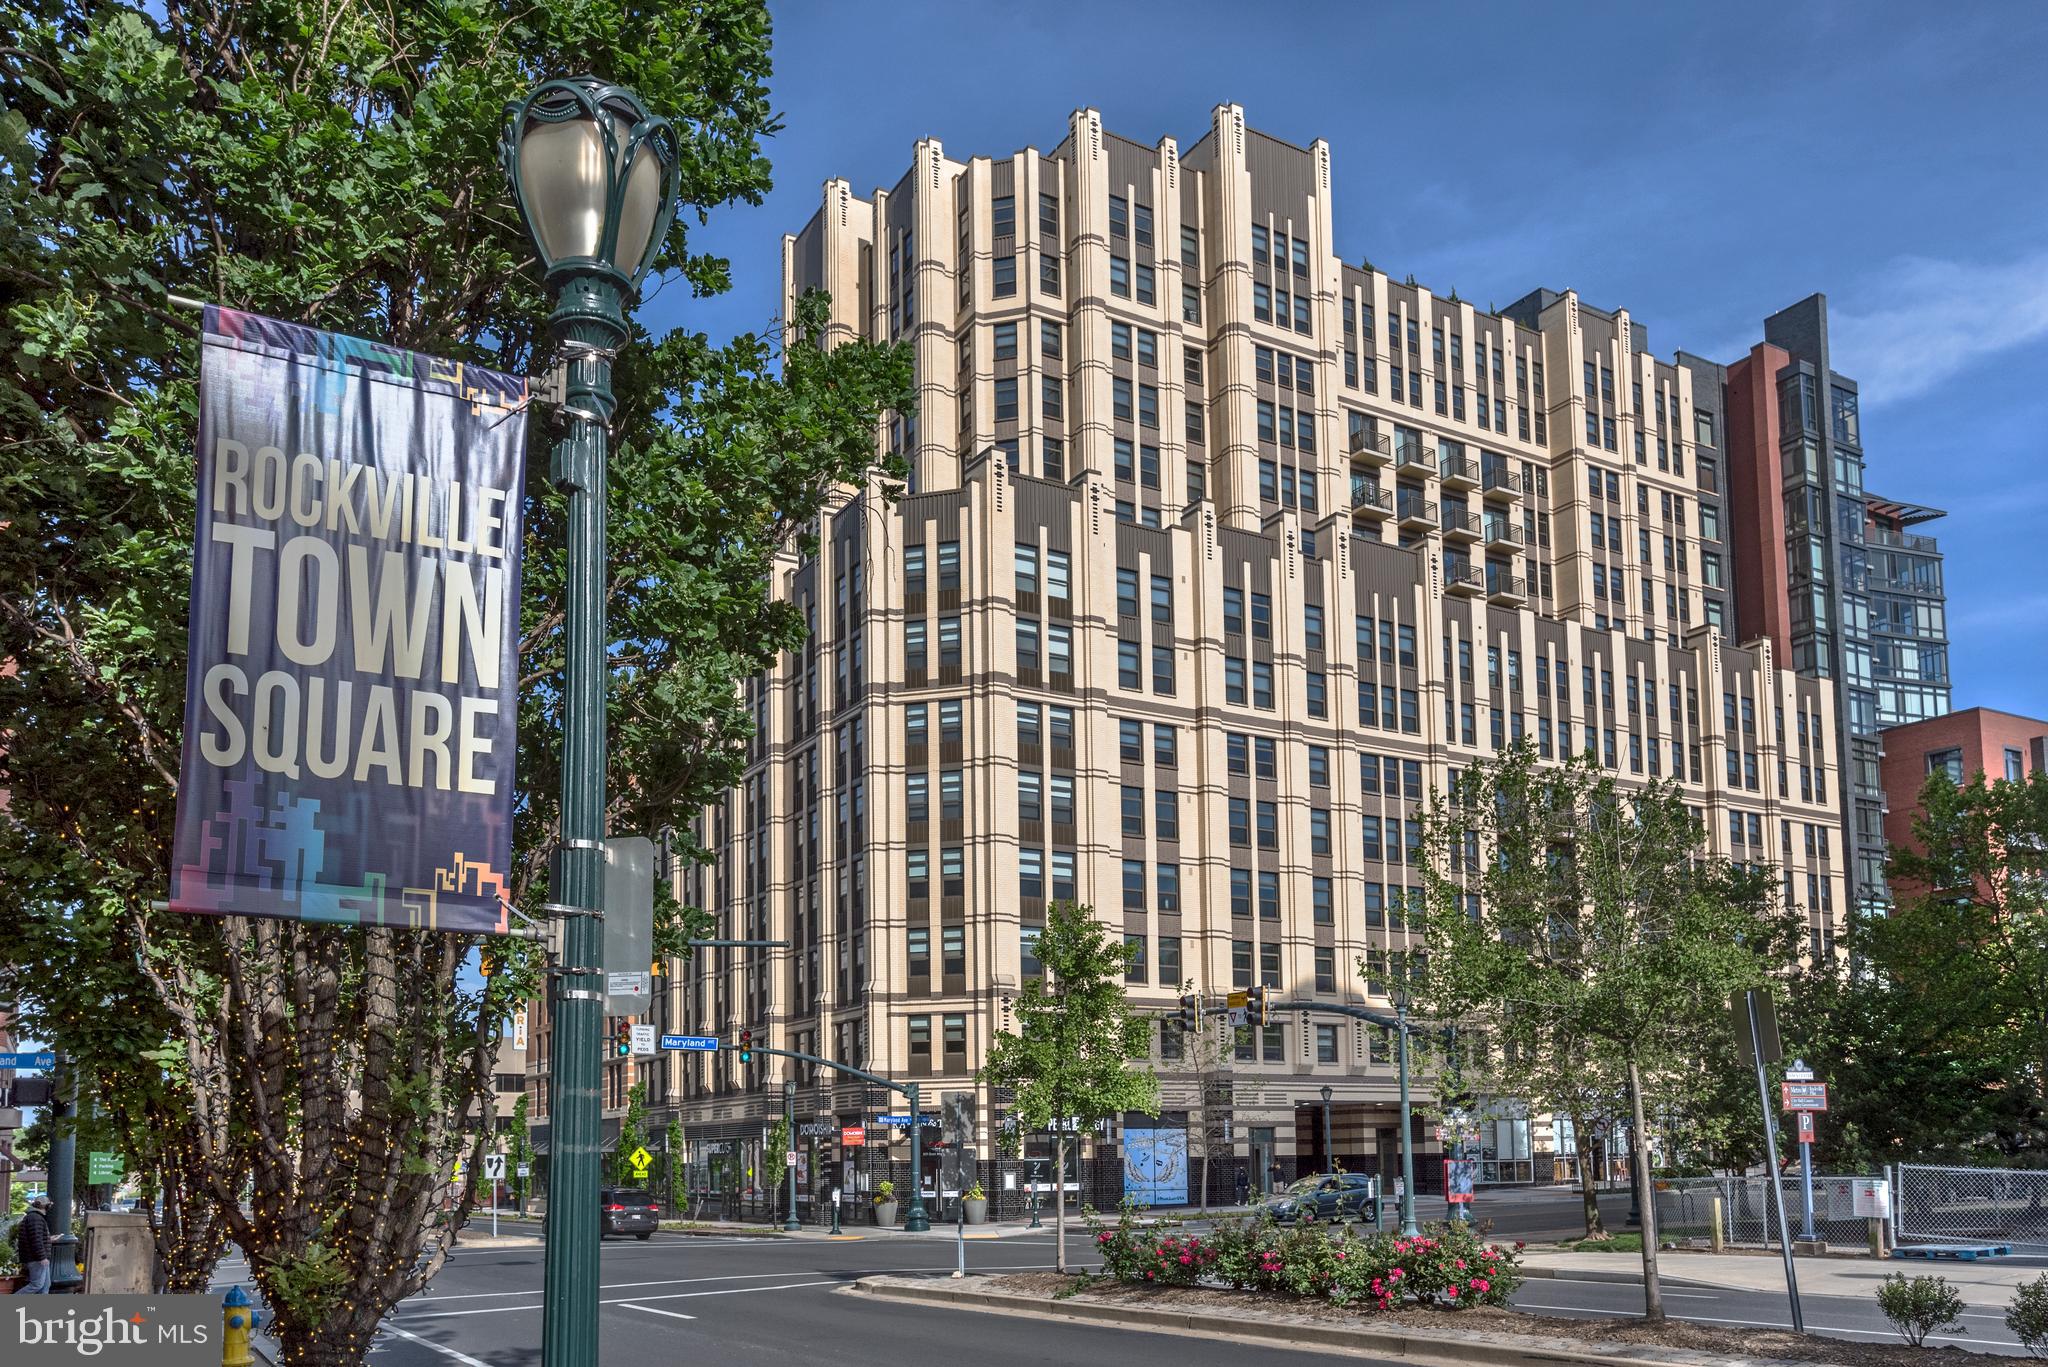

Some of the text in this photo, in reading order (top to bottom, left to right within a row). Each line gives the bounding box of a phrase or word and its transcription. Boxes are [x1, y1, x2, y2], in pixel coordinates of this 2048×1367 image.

[212, 438, 505, 558] ROCKVILLE
[211, 522, 503, 689] TOWN
[200, 663, 498, 796] SQUARE
[34, 1056, 52, 1066] Ave
[664, 1039, 706, 1048] Maryland
[1802, 1115, 1810, 1130] P
